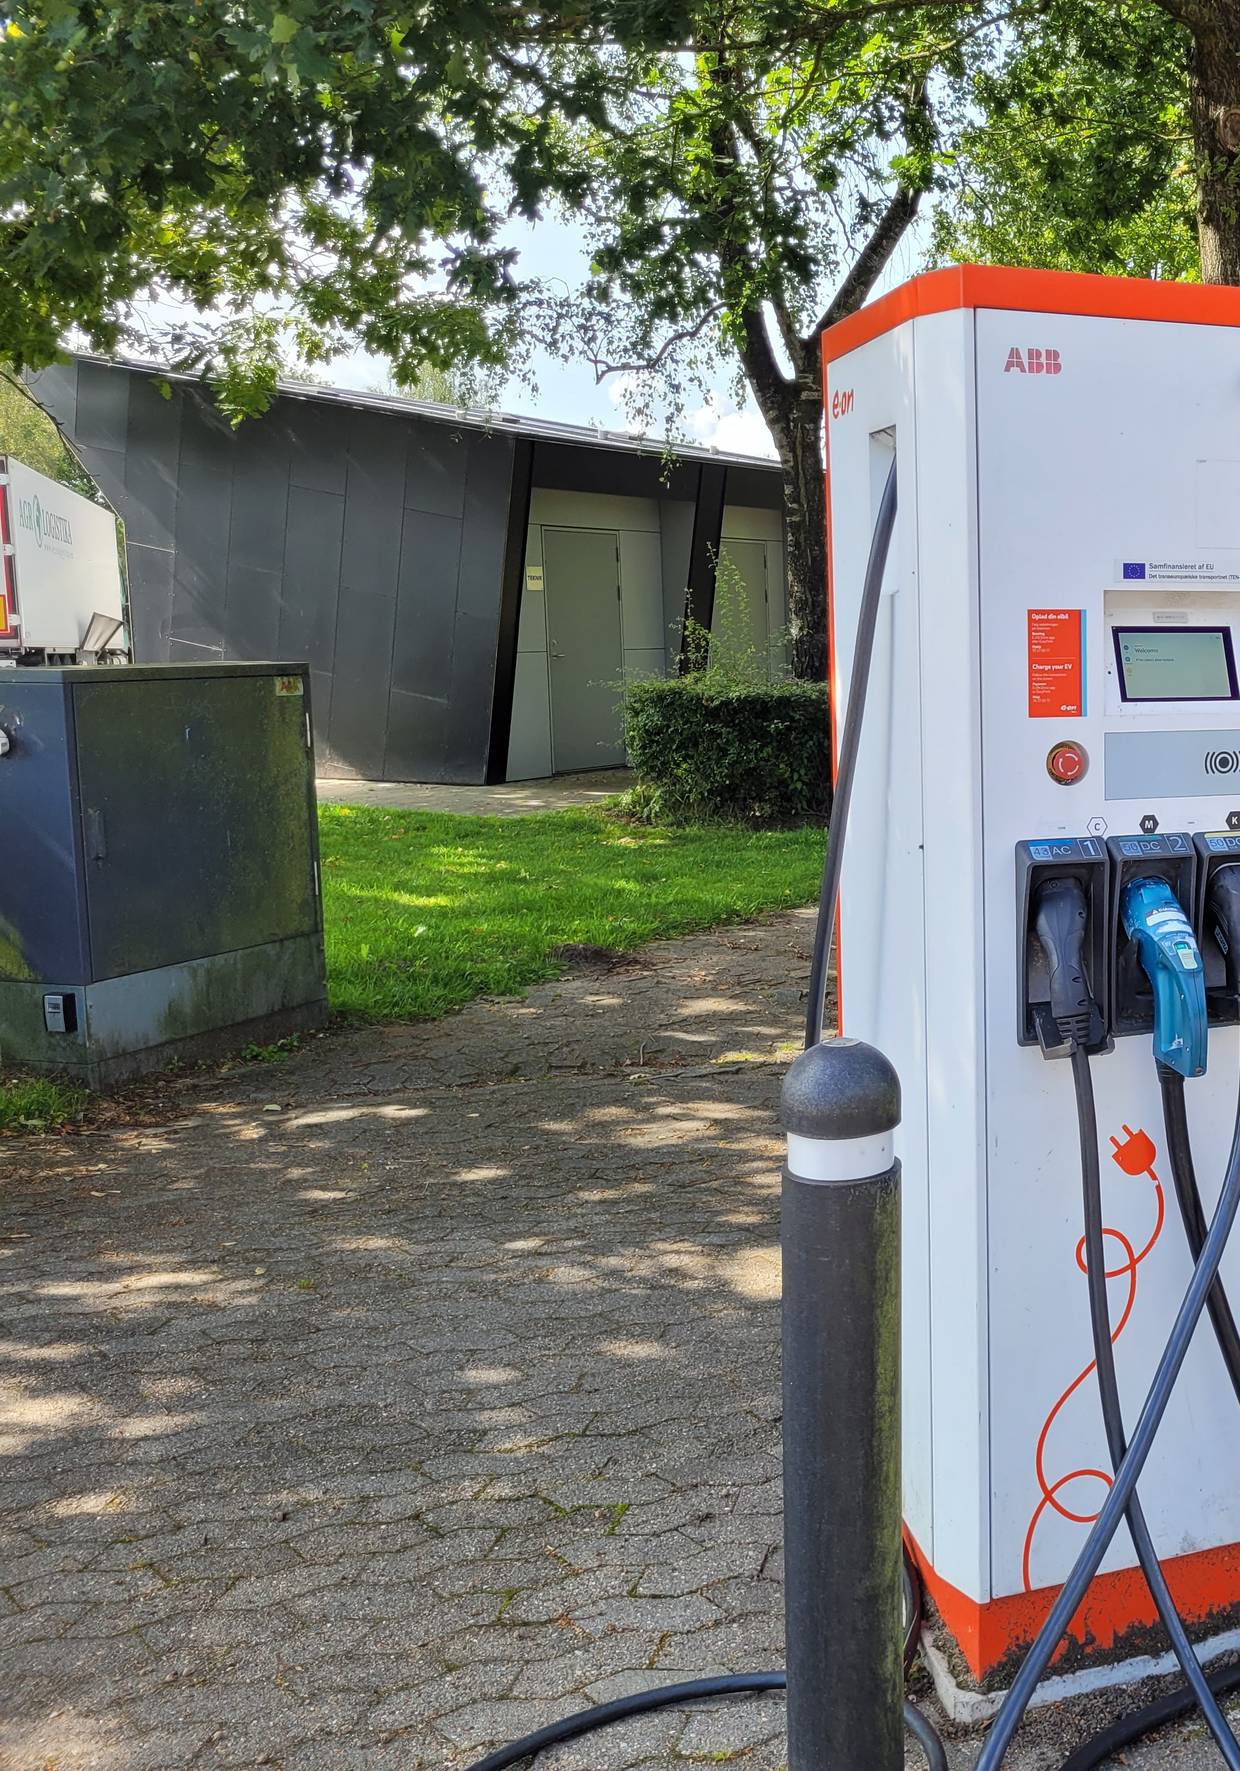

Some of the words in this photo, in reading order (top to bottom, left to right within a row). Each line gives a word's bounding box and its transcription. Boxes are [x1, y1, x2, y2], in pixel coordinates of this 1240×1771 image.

[1003, 347, 1062, 375] ABB
[1148, 562, 1197, 571] Samfinansieret
[1032, 663, 1051, 671] Charge
[1144, 820, 1154, 829] M
[1231, 816, 1239, 825] K
[1094, 822, 1101, 831] C
[1083, 840, 1096, 856] 1
[1139, 841, 1161, 851] DC
[1169, 836, 1187, 851] 2
[1052, 845, 1072, 855] AC
